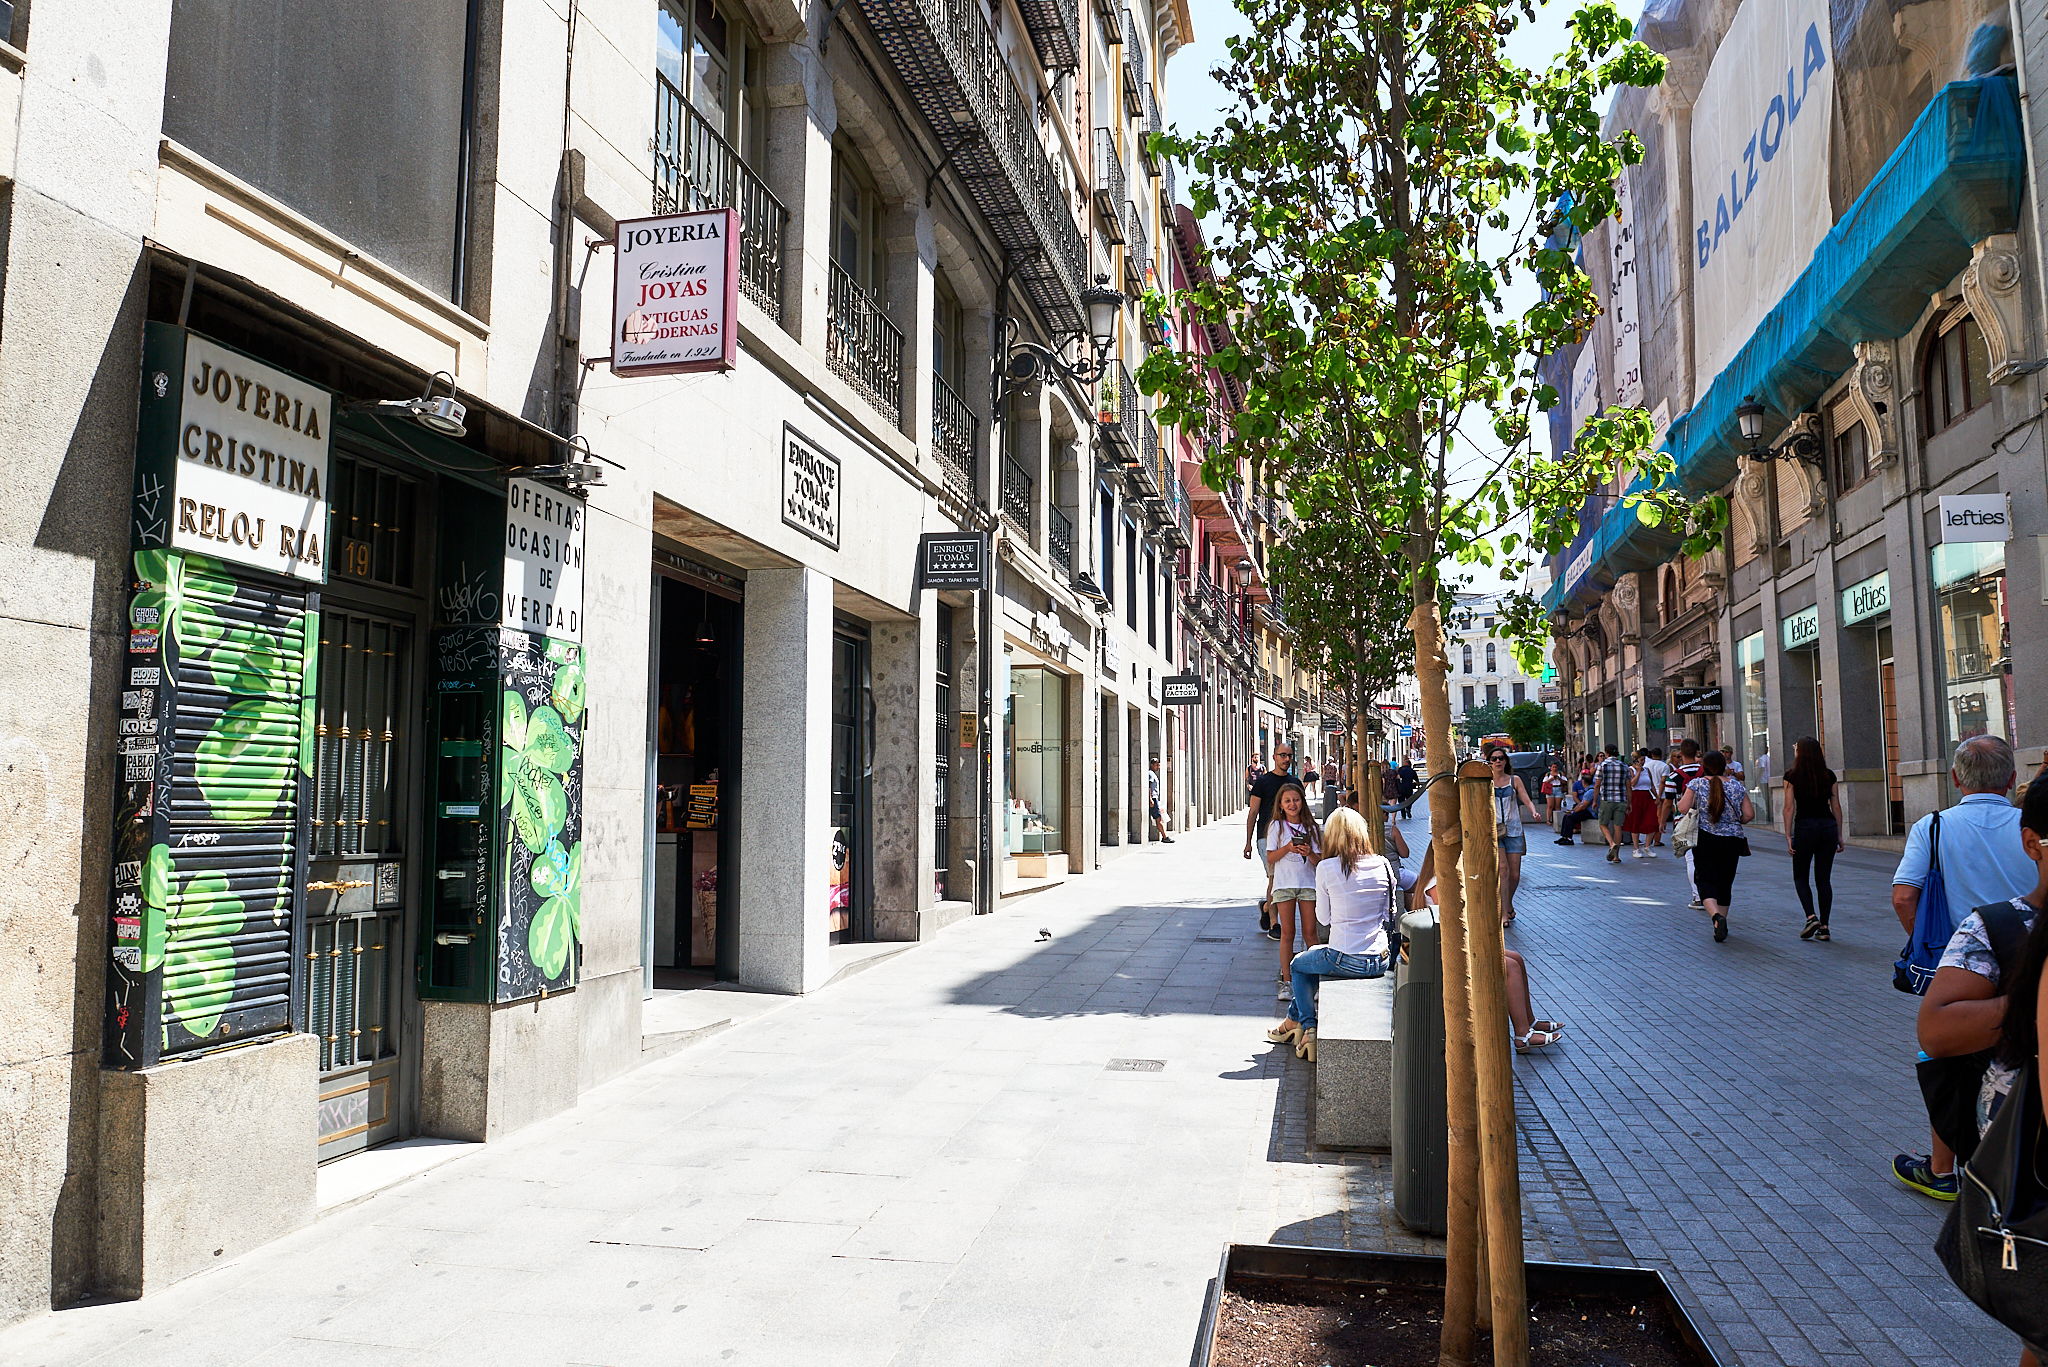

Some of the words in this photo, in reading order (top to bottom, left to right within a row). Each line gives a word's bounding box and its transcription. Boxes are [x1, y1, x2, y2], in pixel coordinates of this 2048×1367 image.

[1696, 20, 1827, 271] BALZOLA
[624, 222, 720, 253] JOYERIA
[639, 261, 707, 281] Cristina
[637, 279, 707, 307] JOYAS
[642, 308, 708, 324] NTIGUAS
[619, 350, 667, 364] Fundada
[670, 352, 681, 360] en
[193, 362, 321, 440] JOYERIA
[182, 425, 321, 499] CRISTINA
[789, 440, 835, 490] ENRIQUE
[511, 484, 581, 531] OFERTAS
[1946, 510, 2005, 526] lefties
[179, 497, 265, 549] RELOJ
[345, 541, 368, 576] 19
[508, 522, 581, 569] OCASION
[933, 545, 974, 553] ENRIQUE
[540, 568, 552, 589] DE
[507, 593, 577, 632] VERDAD
[1853, 586, 1886, 616] lefties
[1791, 617, 1816, 642] lefties
[1677, 697, 1701, 711] Salvador
